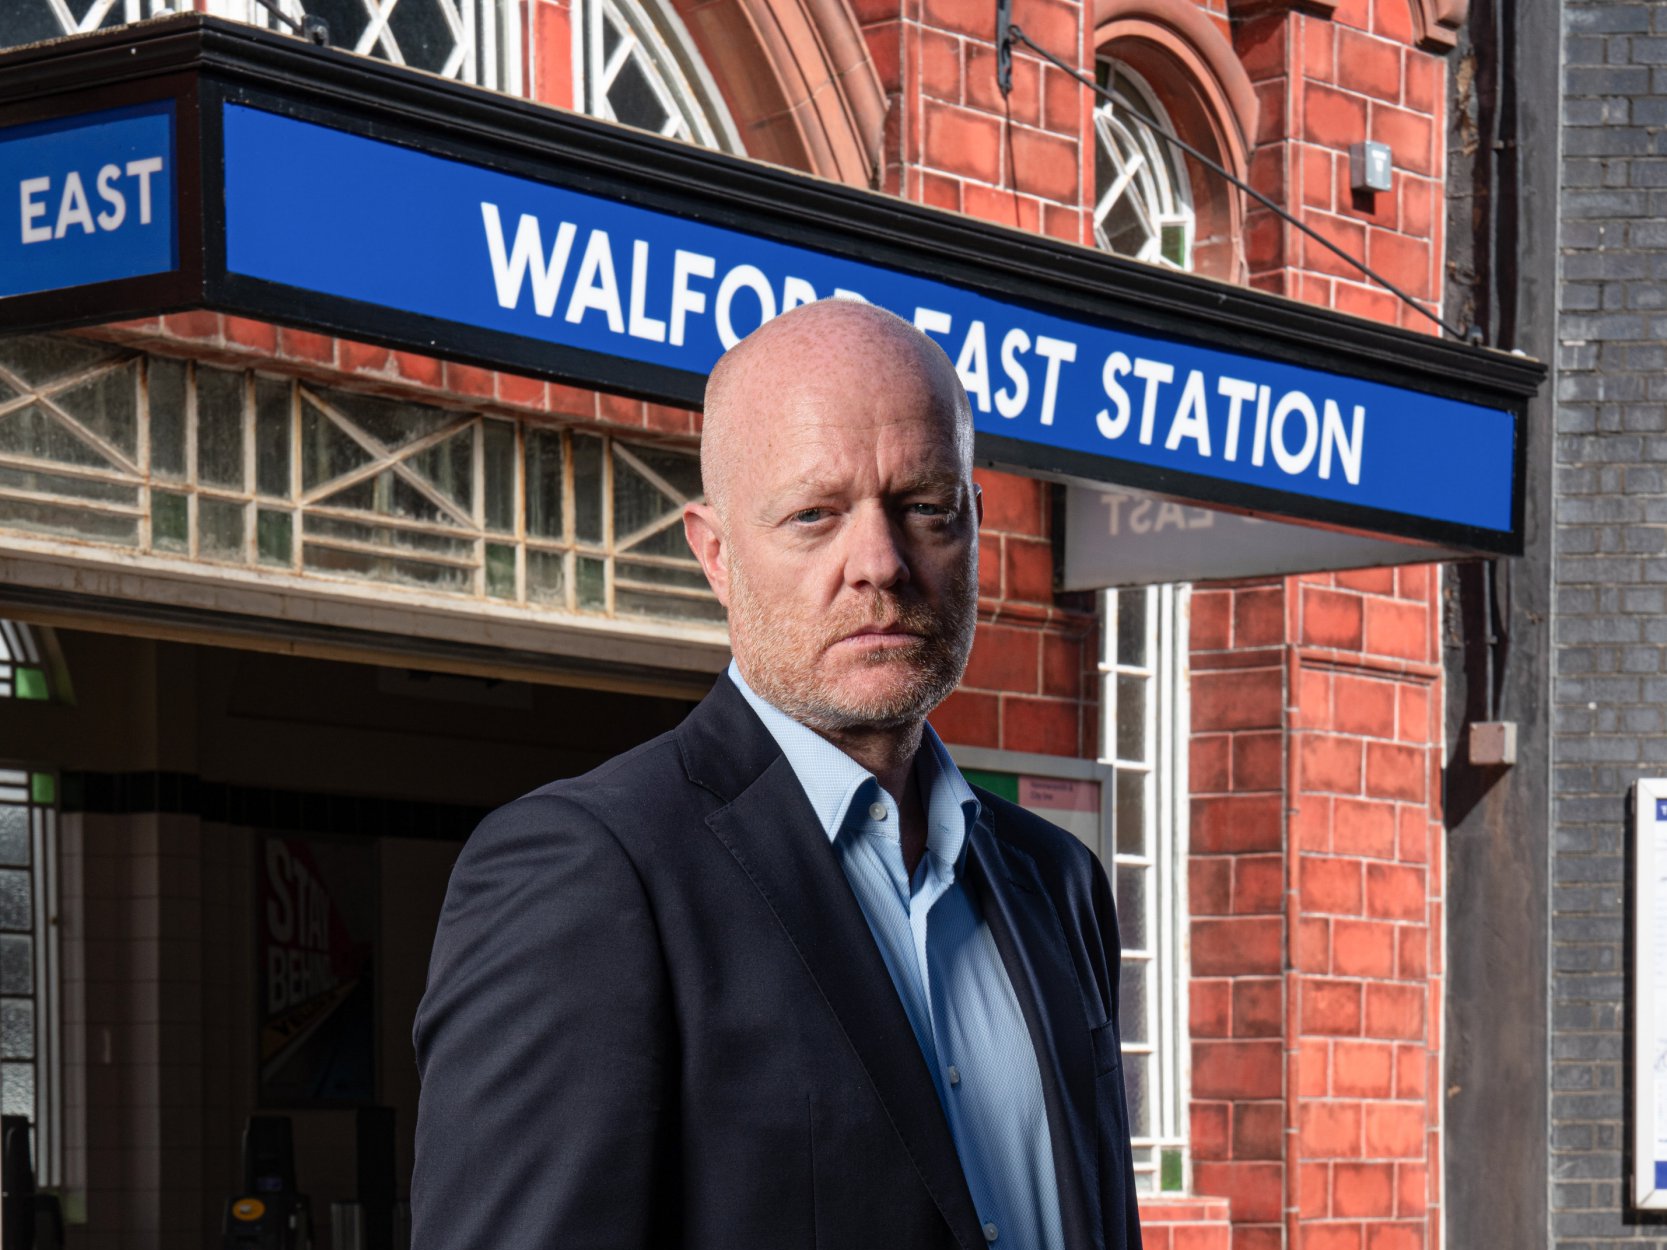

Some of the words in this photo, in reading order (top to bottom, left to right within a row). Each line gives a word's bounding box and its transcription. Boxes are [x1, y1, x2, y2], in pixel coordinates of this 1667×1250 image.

[20, 156, 163, 245] EAST
[480, 201, 868, 352] WALFO
[1096, 351, 1366, 486] STATION
